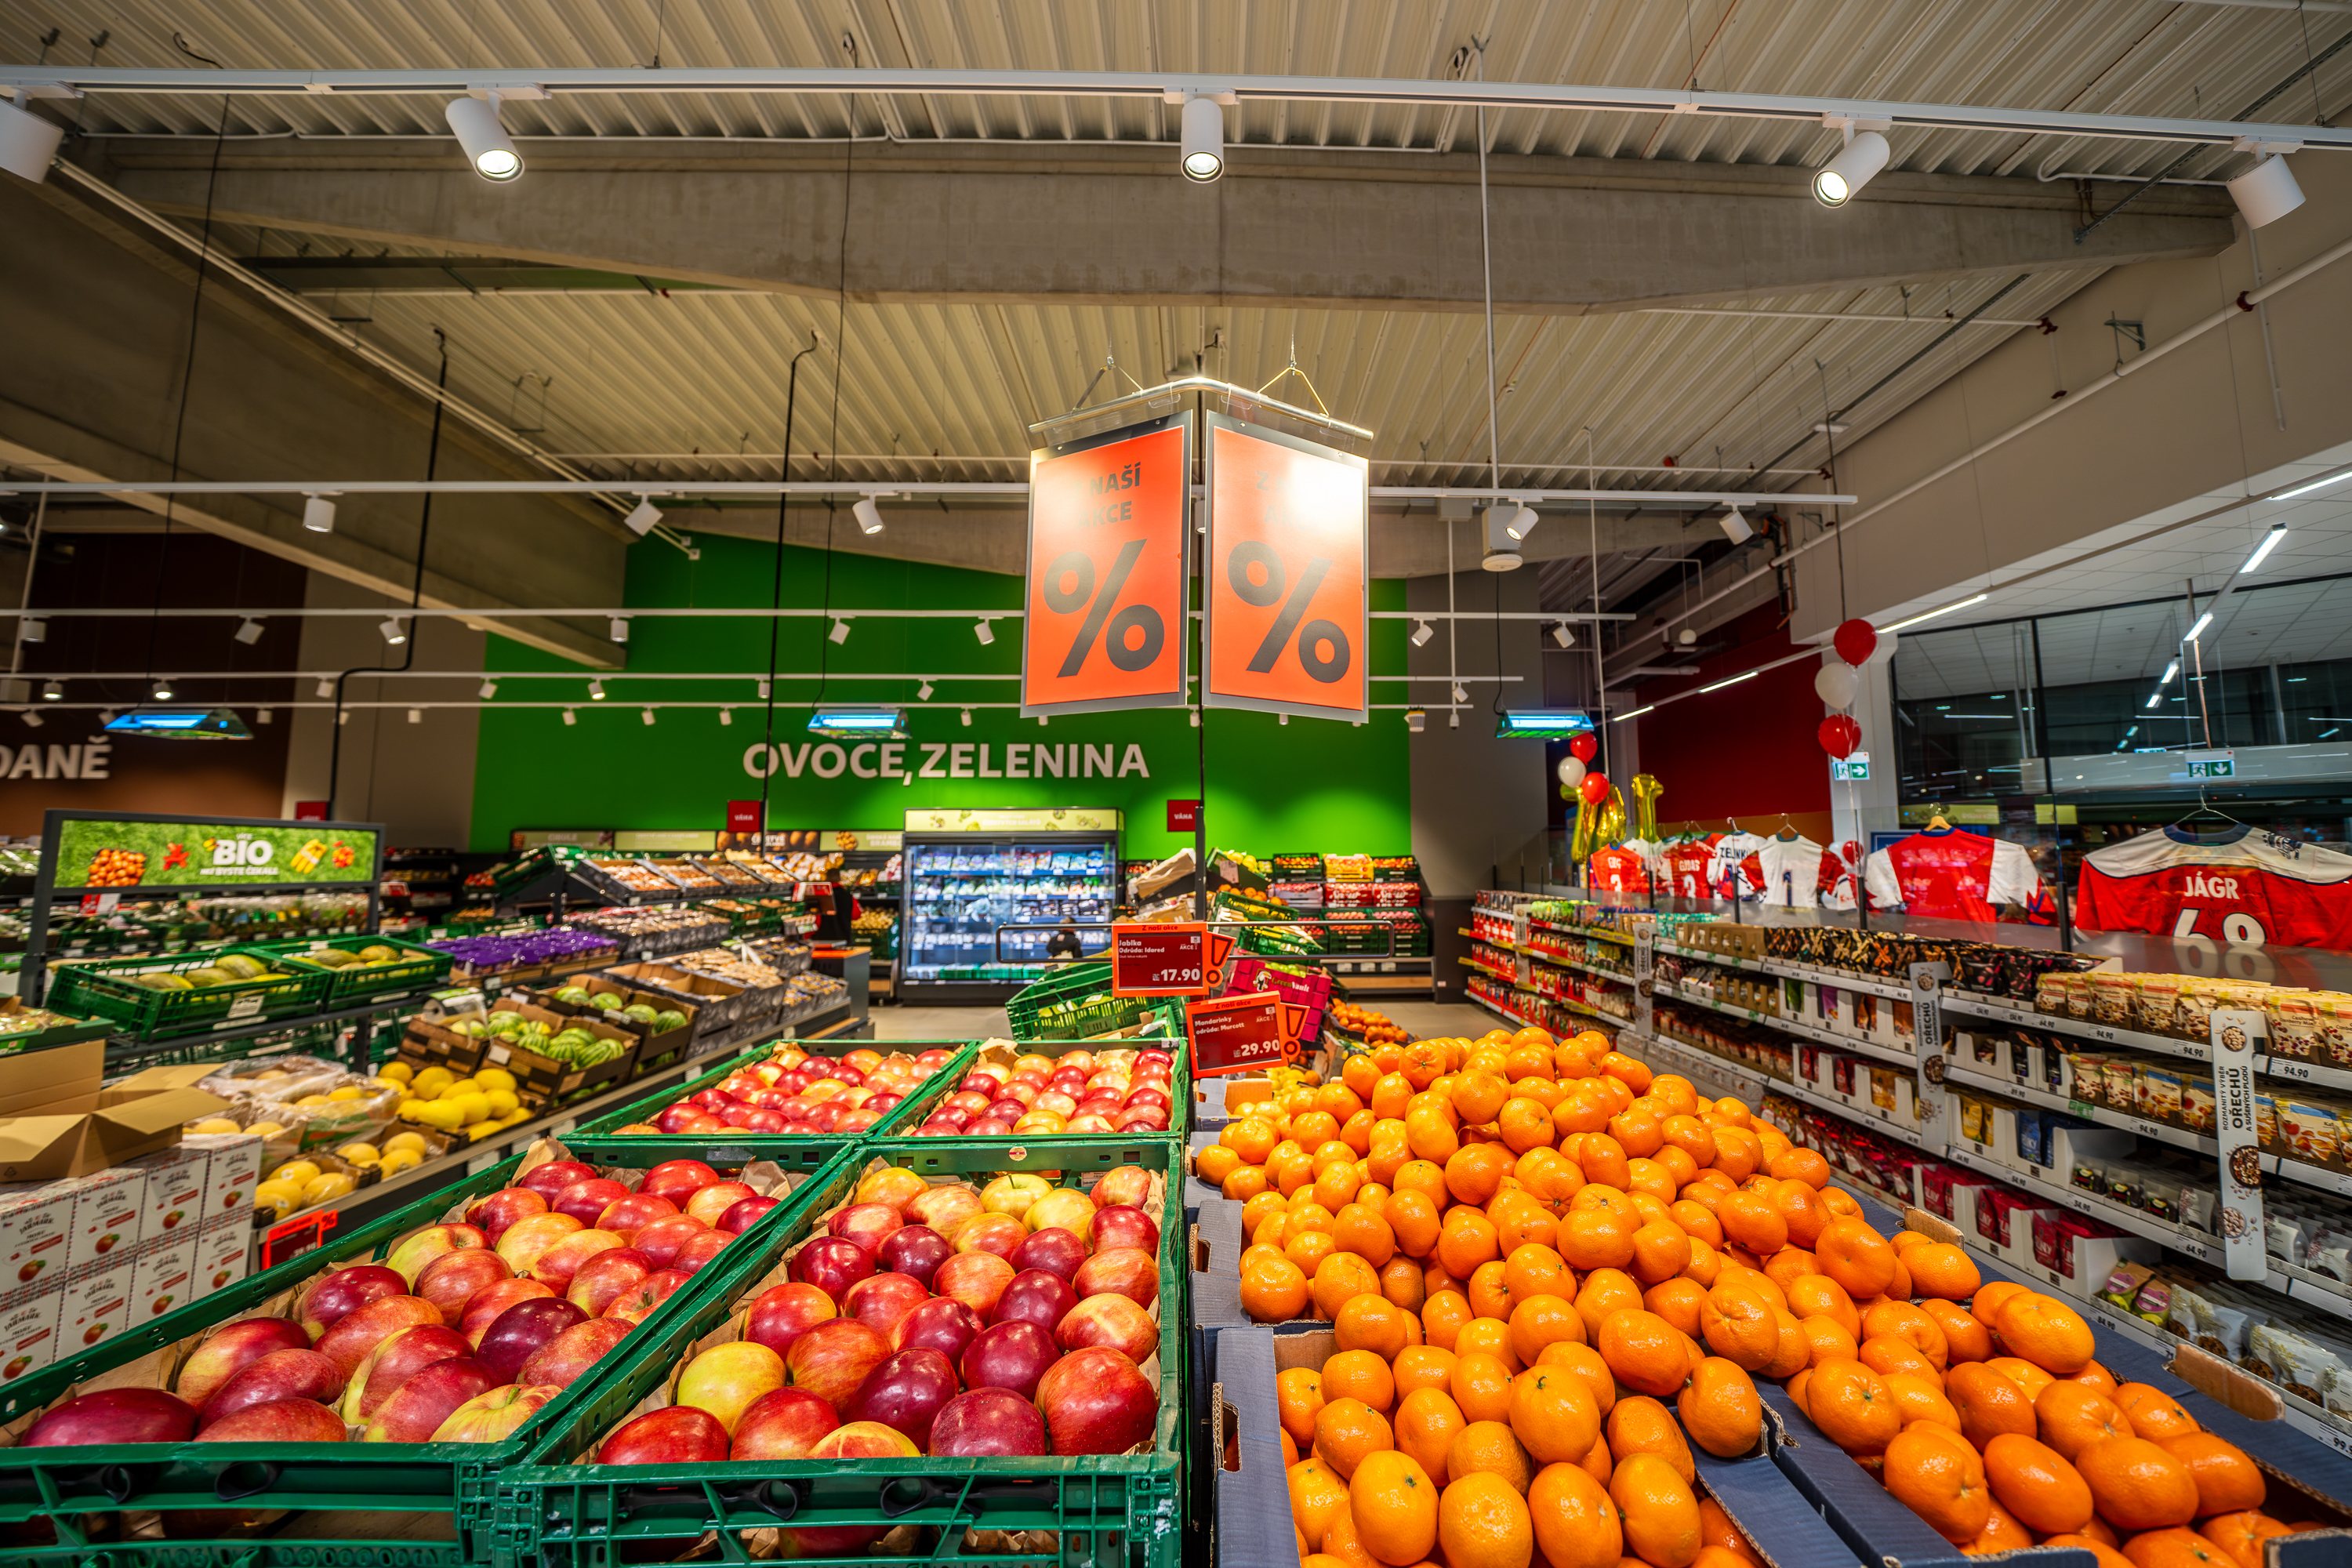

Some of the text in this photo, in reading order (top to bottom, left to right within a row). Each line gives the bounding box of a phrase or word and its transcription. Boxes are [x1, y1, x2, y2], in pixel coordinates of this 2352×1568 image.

[1090, 461, 1141, 498] NAŠÍ
[1076, 500, 1133, 530] AKCE
[1044, 539, 1164, 678] %
[1227, 541, 1350, 684] %
[743, 742, 1150, 786] OVOCE, ZELENINA
[212, 840, 274, 866] BIO
[2184, 871, 2241, 900] JÁGR
[1161, 968, 1200, 982] 17.90
[1195, 1016, 1232, 1026] Mandarinky
[1196, 1022, 1244, 1035] odrůda: Murcott
[1921, 1003, 1933, 1044] OŘECHŮ
[2096, 1029, 2114, 1040] 94.90
[1241, 1040, 1280, 1057] 29.90
[2183, 1046, 2204, 1058] 94.90
[2241, 1065, 2250, 1091] PLODŮ
[2284, 1065, 2309, 1078] 94.90
[2219, 1091, 2229, 1131] ROZMANITÝ
[2225, 1068, 2244, 1129] OŘECHŮ
[2242, 1091, 2252, 1126] SUŠENÝCH
[2139, 1124, 2158, 1136] 94.90
[2186, 1243, 2207, 1258] 64.90
